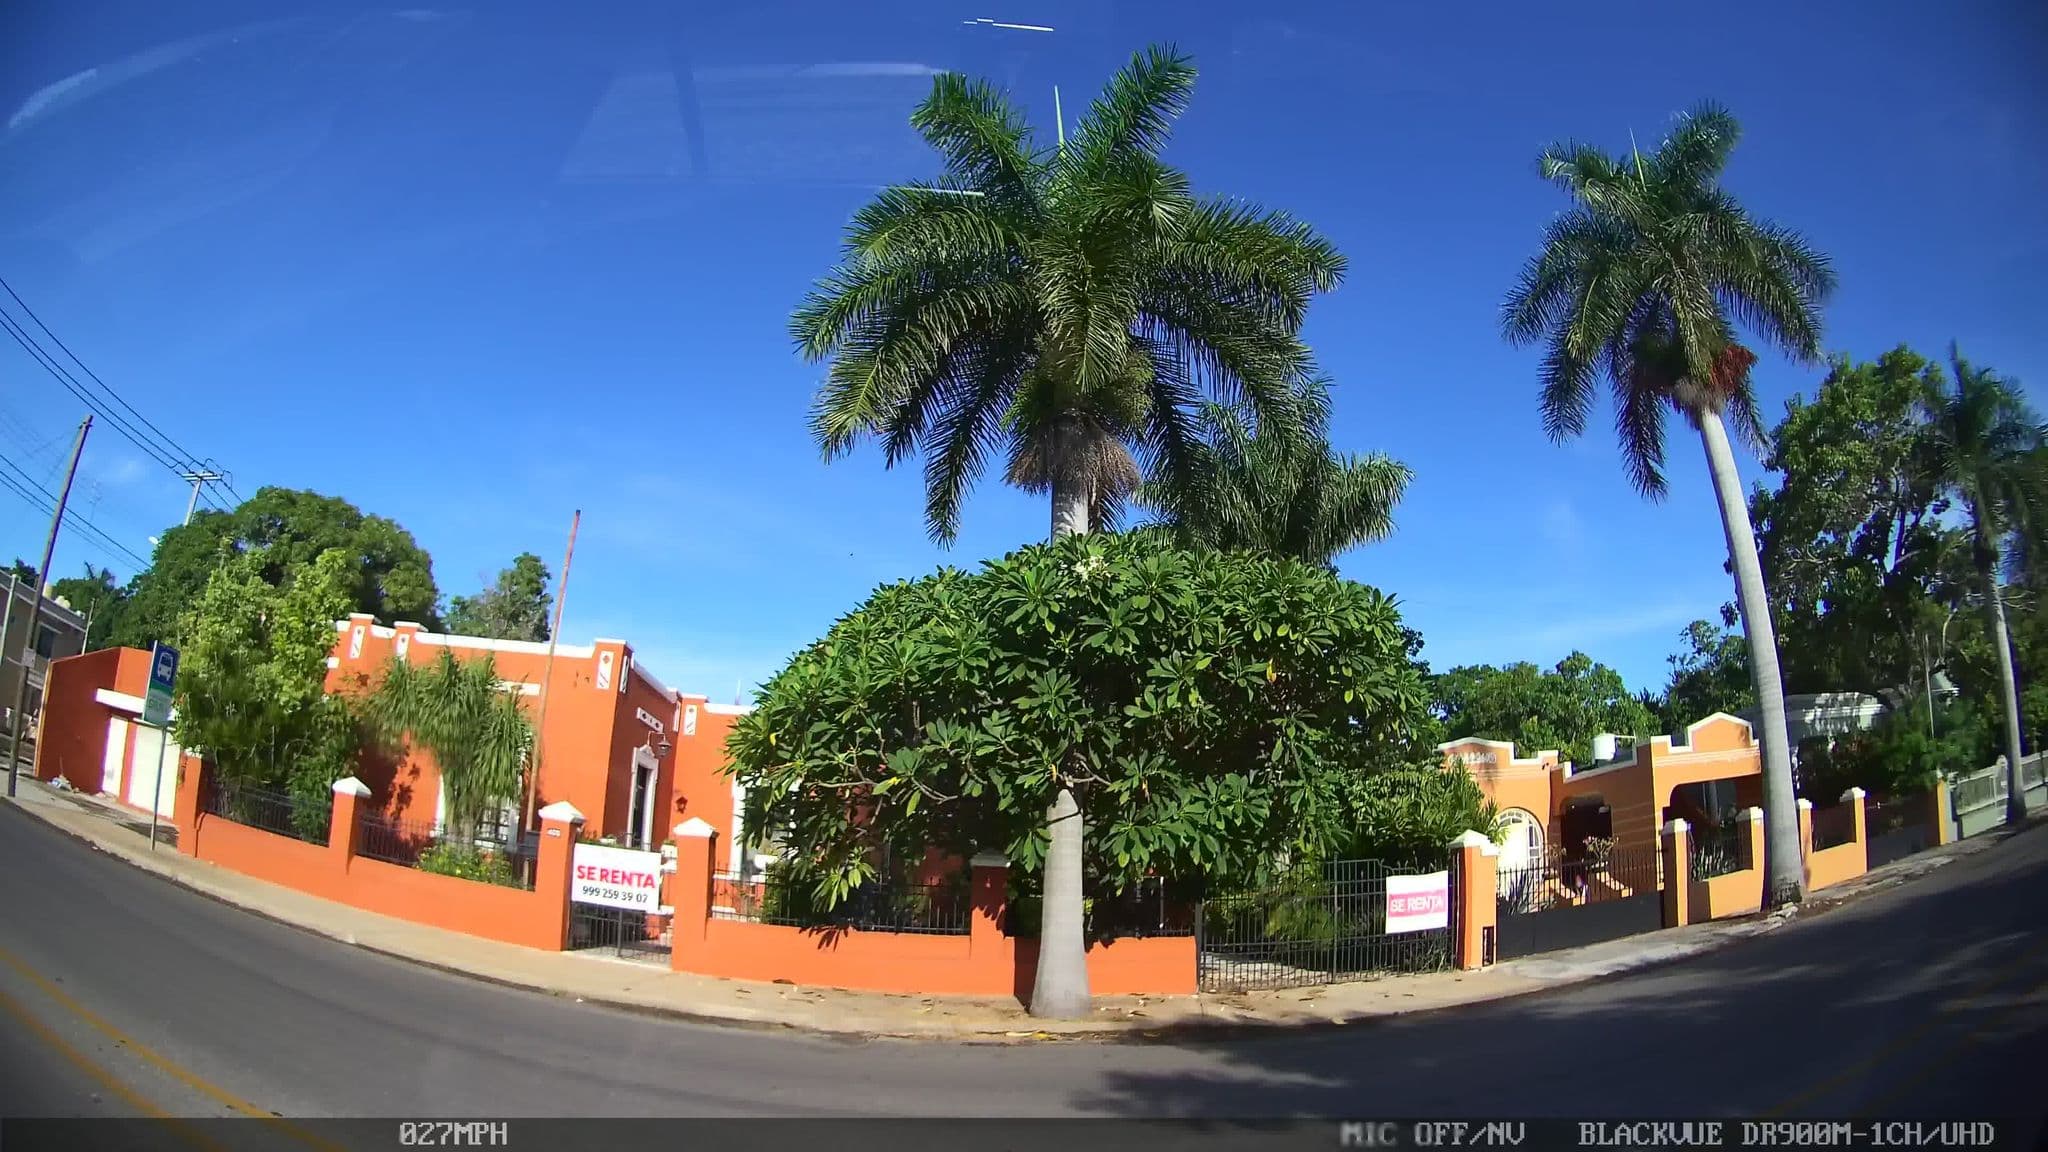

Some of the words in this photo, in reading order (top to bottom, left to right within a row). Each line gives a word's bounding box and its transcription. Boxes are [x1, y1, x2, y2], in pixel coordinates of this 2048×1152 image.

[577, 865, 596, 880] SE
[600, 868, 655, 888] RENTA
[582, 885, 600, 896] 999
[1391, 899, 1406, 912] SE
[1407, 896, 1444, 911] RENTA
